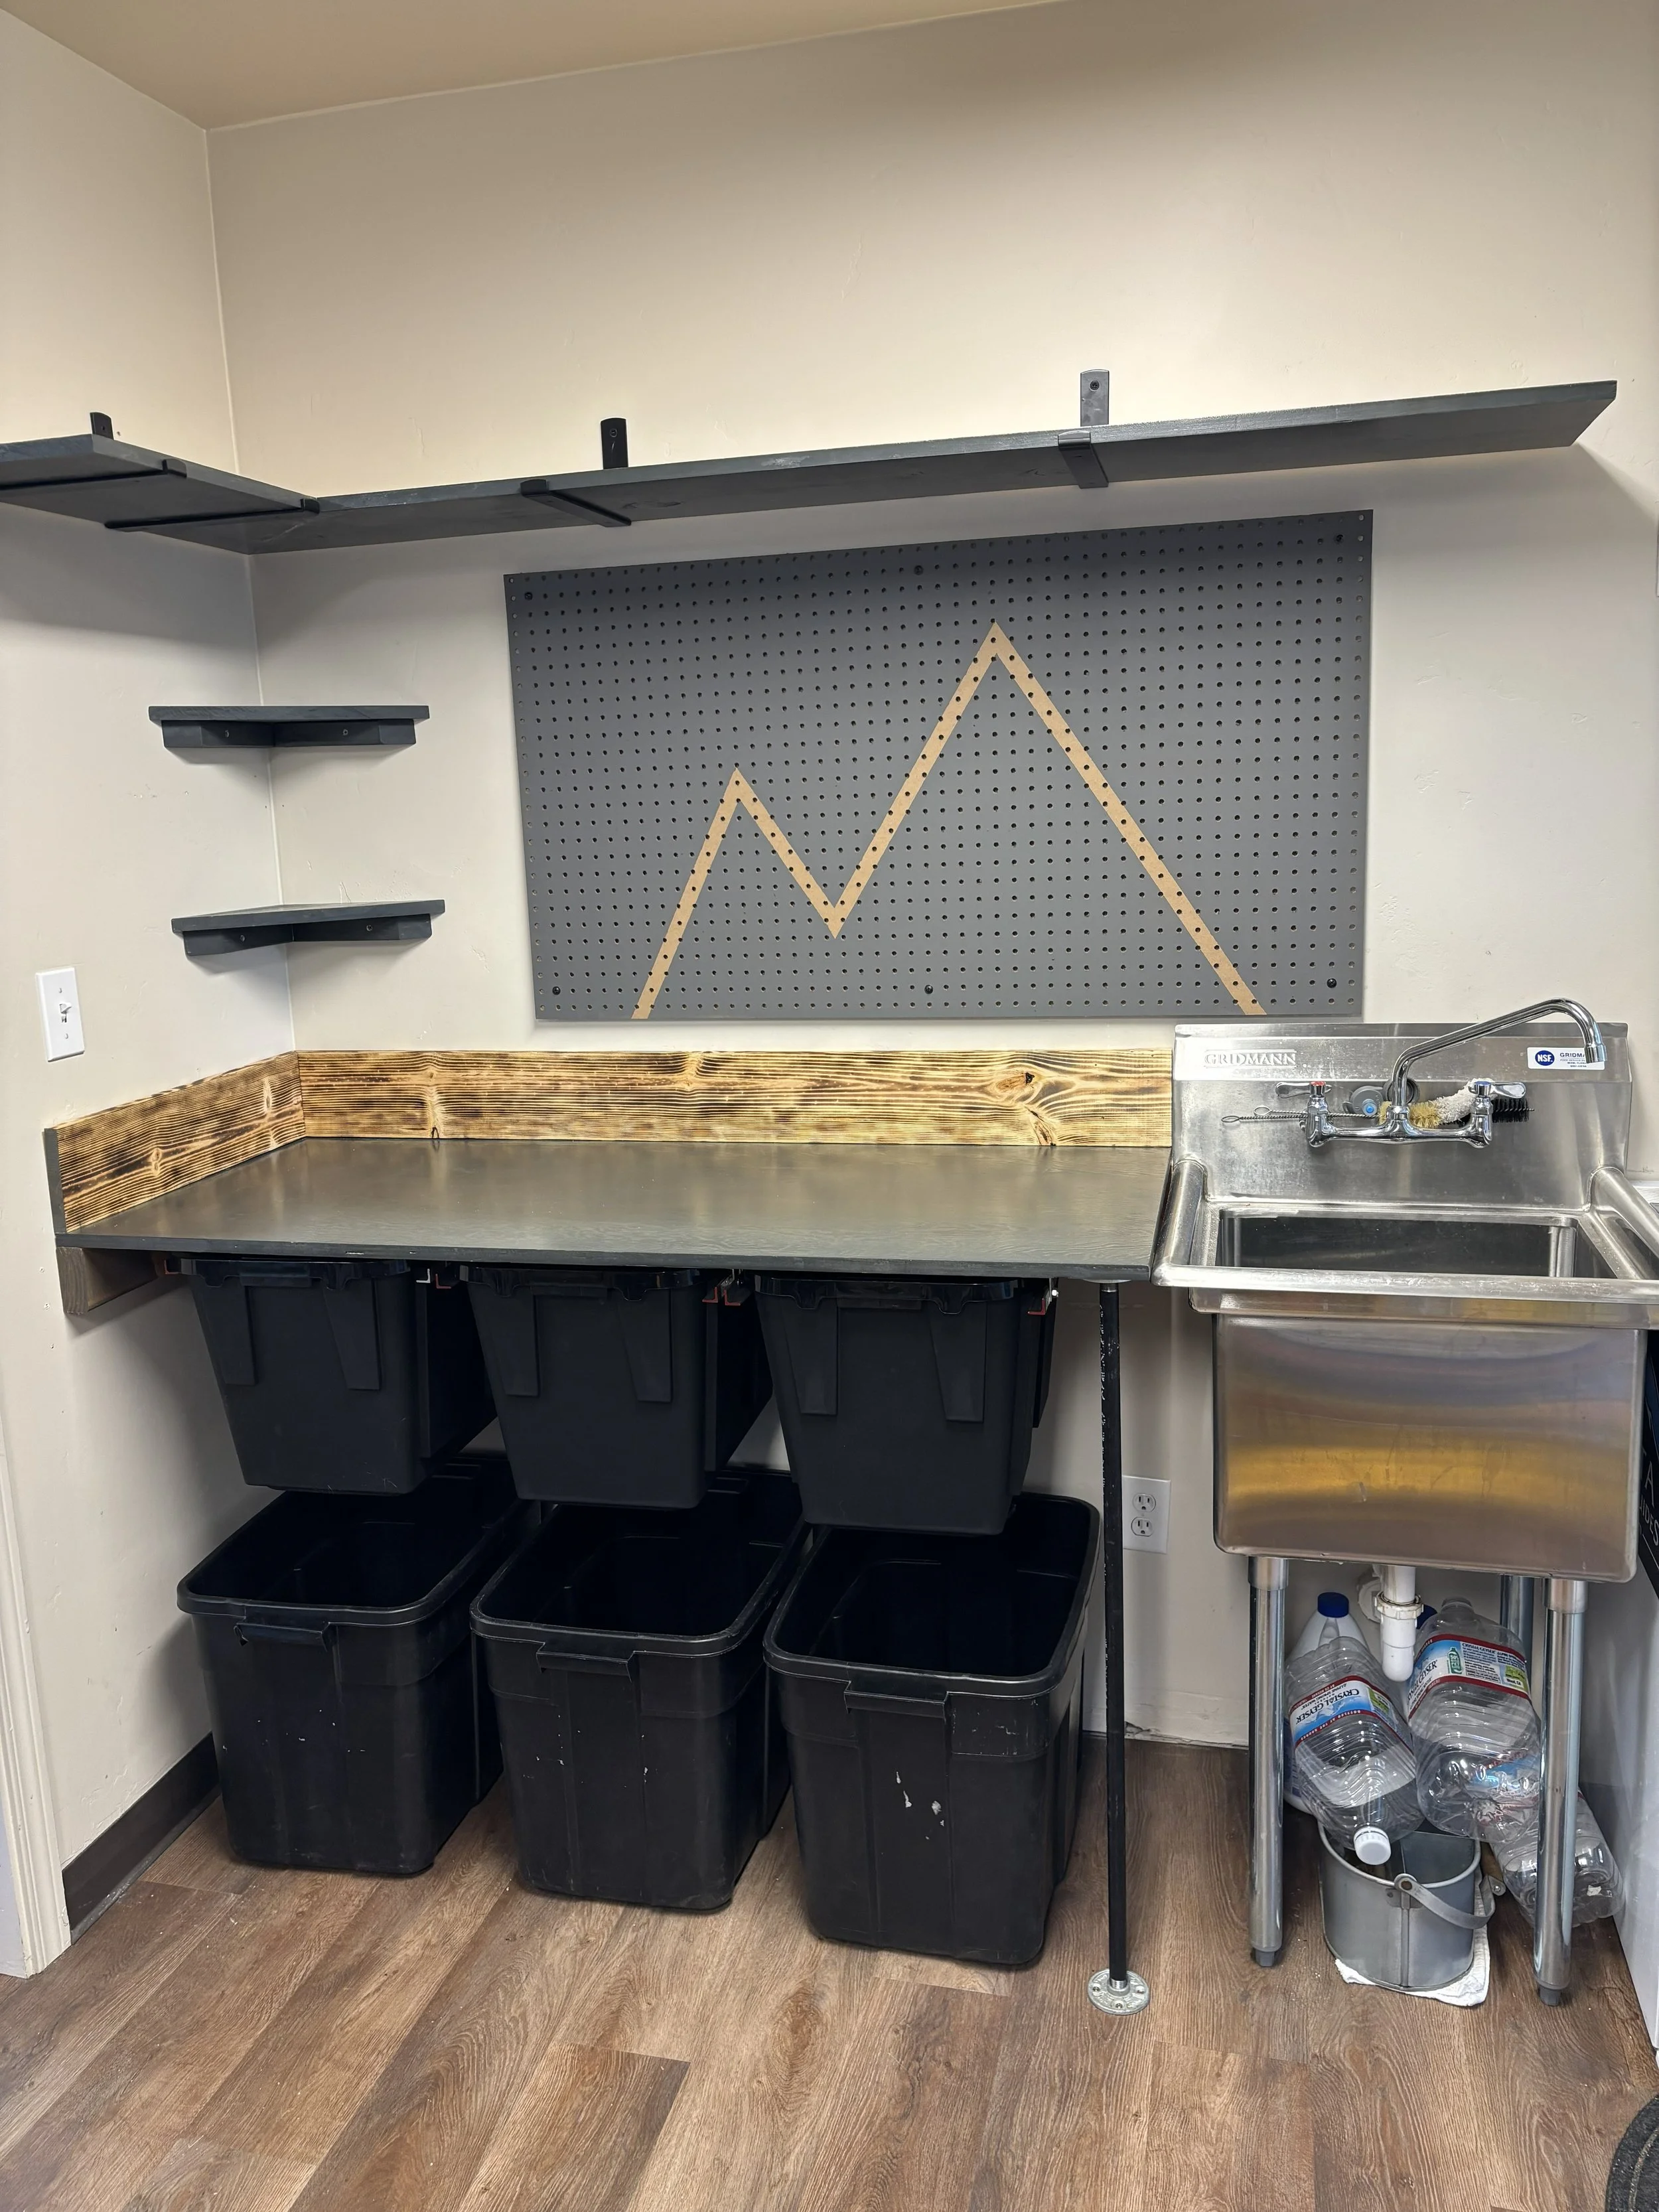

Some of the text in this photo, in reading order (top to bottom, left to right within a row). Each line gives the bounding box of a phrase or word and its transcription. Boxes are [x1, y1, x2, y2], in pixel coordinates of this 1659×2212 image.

[1204, 1053, 1296, 1066] GRIDMANN
[1324, 1688, 1360, 1707] CRYSTAL
[1296, 1702, 1324, 1724] GEYSER
